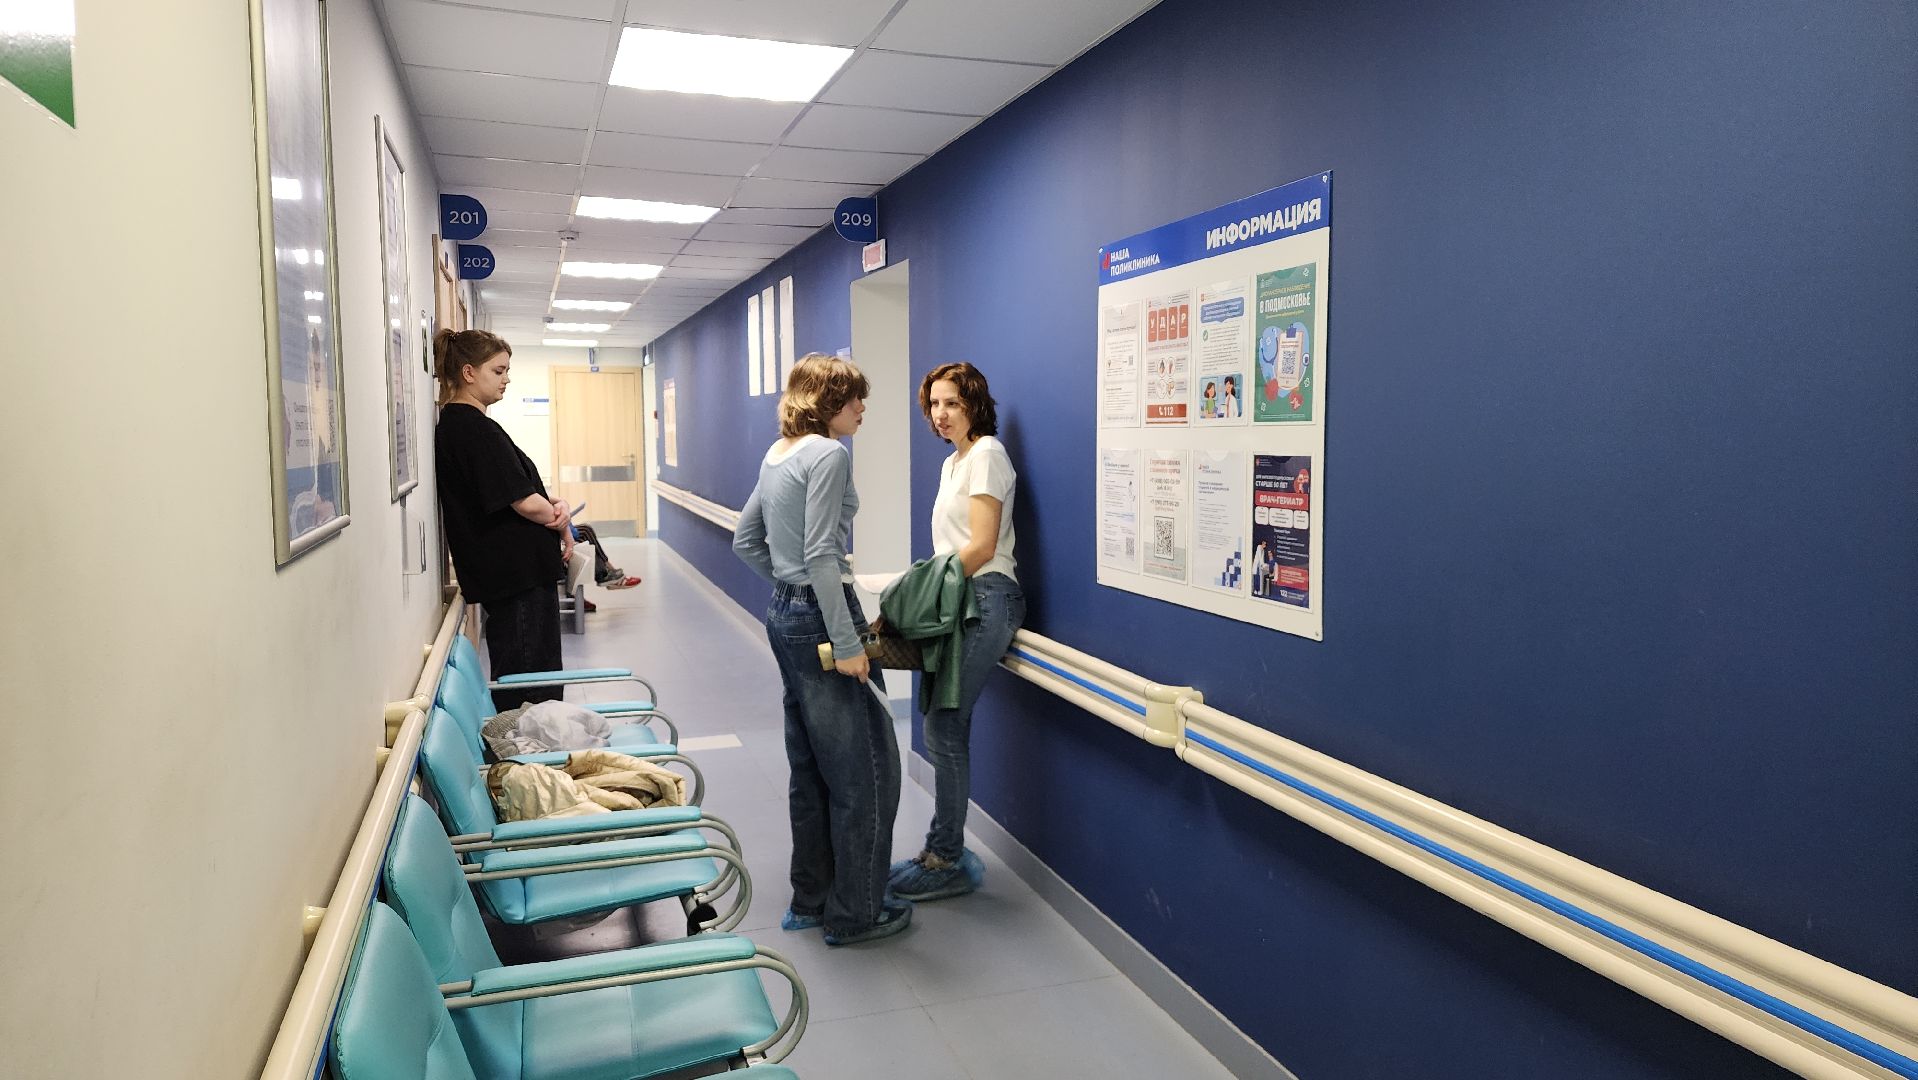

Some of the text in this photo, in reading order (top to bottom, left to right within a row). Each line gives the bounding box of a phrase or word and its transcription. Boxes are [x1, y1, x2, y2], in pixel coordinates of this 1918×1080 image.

[449, 210, 479, 225] 201
[841, 212, 872, 227] 209
[1206, 197, 1322, 251] ИНФОРМАЦИЯ
[1110, 247, 1130, 262] НАША
[463, 257, 490, 268] 202
[1110, 253, 1160, 277] ПОЛИКЛИНИКА
[1264, 291, 1311, 313] ПОДМОСКОВЬЕ
[1163, 406, 1174, 416] 112
[1259, 494, 1304, 506] ВРАЧ-ГЕРИАТР
